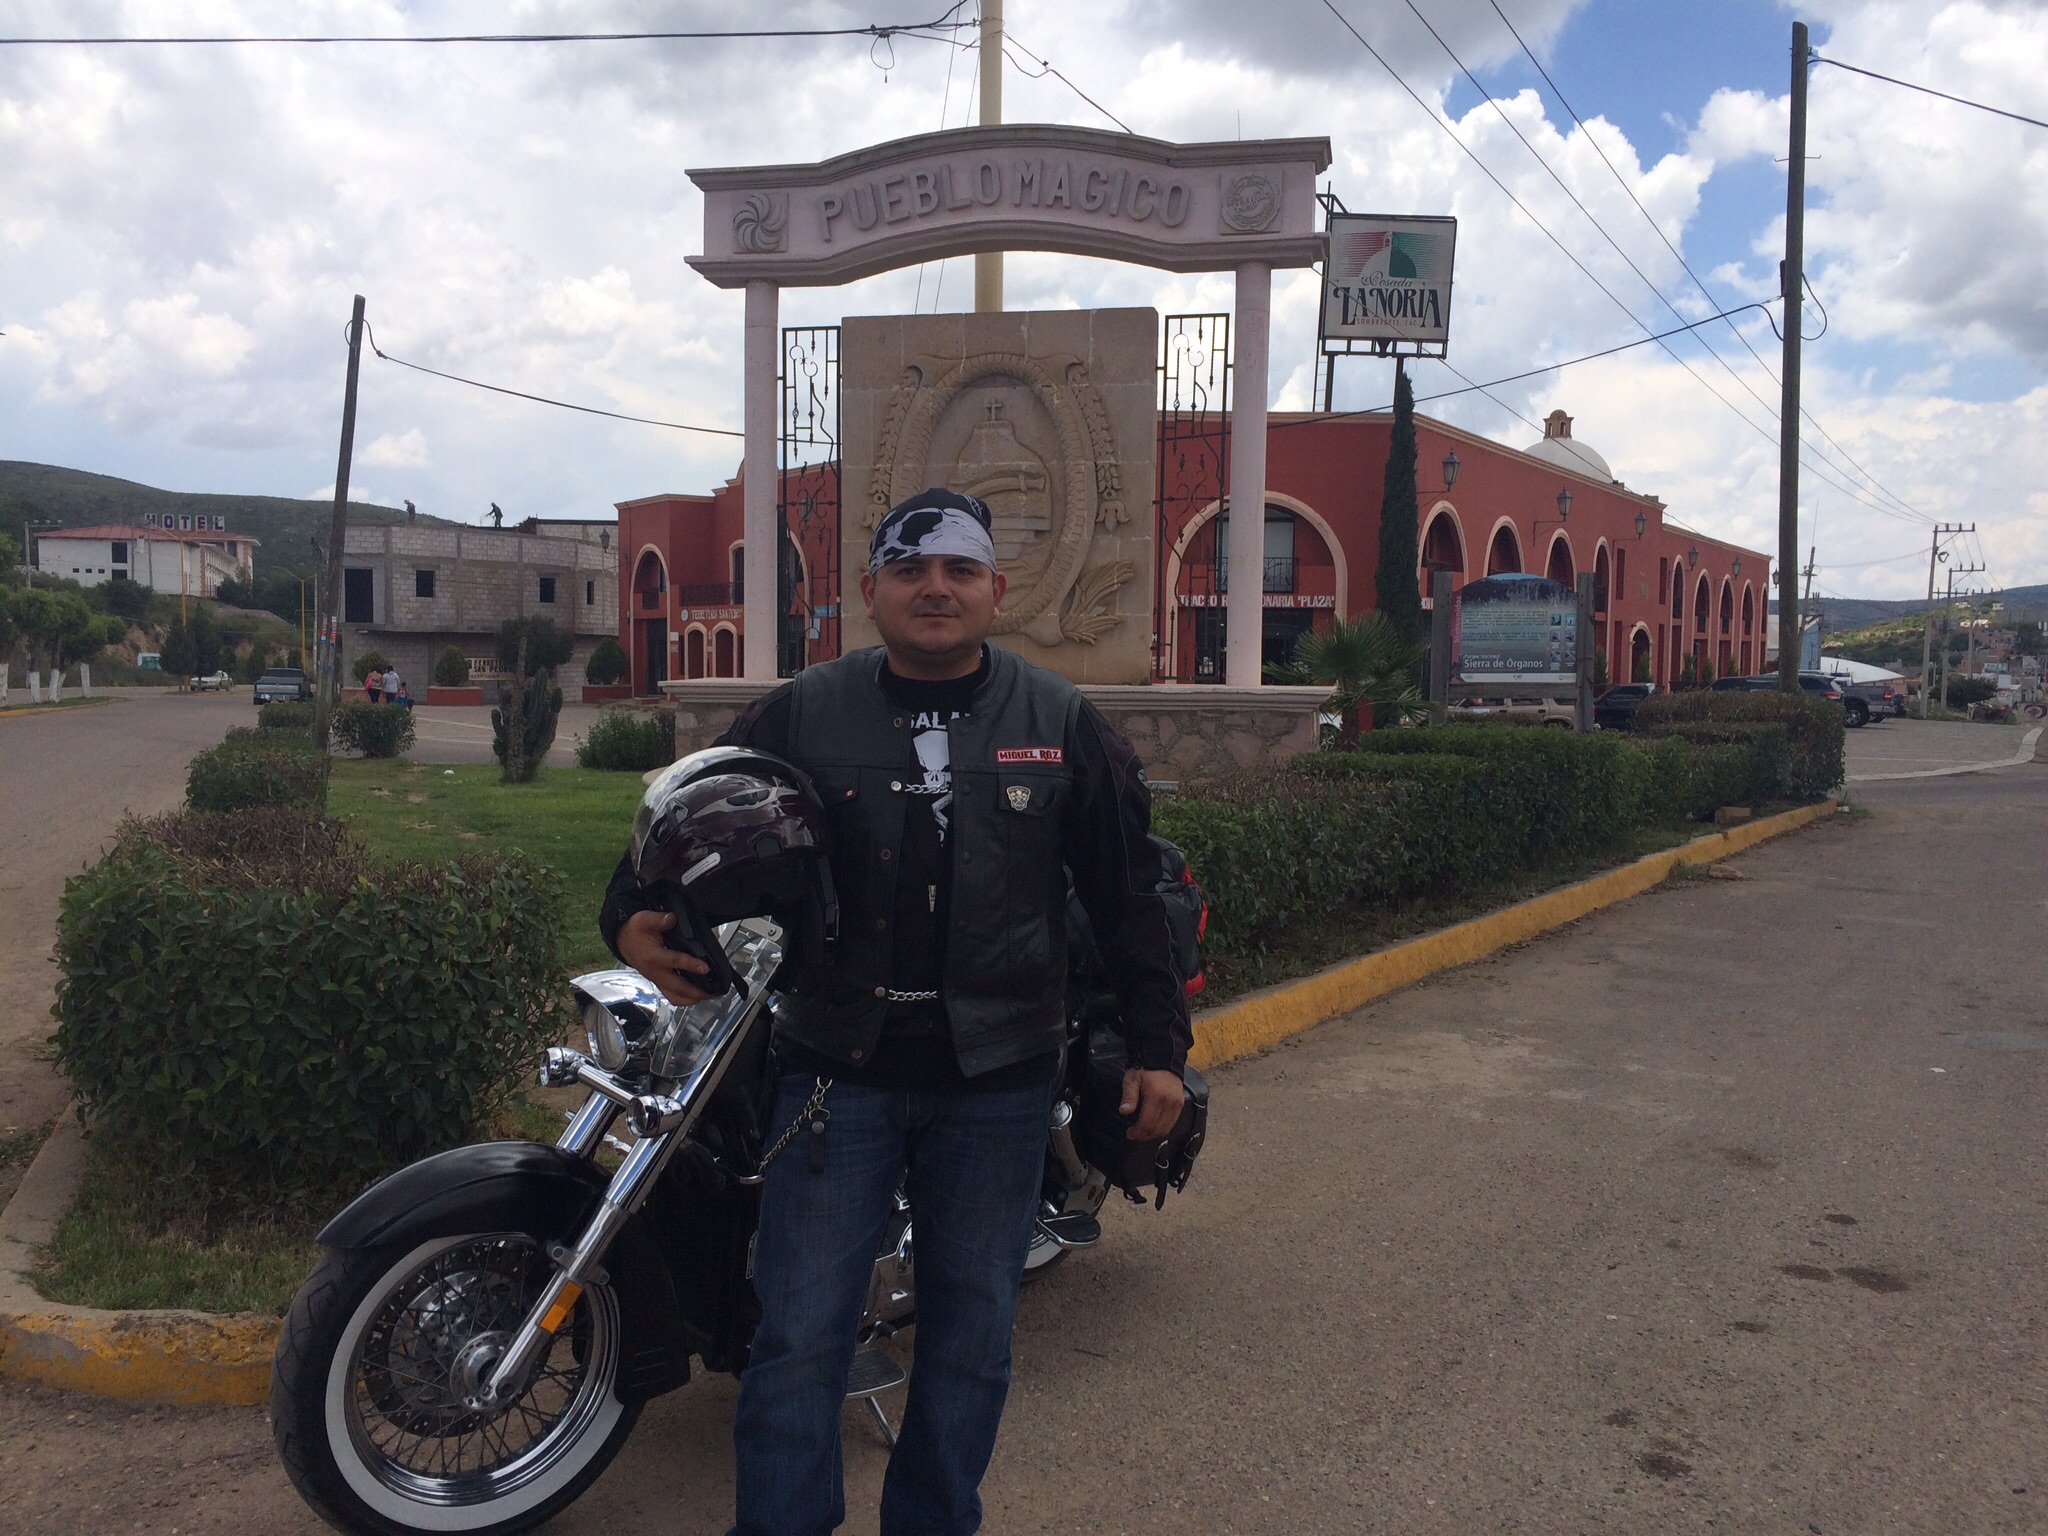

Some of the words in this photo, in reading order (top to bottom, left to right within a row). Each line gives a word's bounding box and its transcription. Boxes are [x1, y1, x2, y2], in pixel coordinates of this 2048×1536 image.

[819, 160, 1001, 242] PUEBLO
[1012, 158, 1190, 228] MAGICO
[1361, 271, 1413, 287] Posada
[145, 513, 224, 531] HOTEL
[1179, 595, 1217, 607] TRACO
[1464, 659, 1490, 668] Sierra
[1493, 659, 1504, 668] de
[1506, 657, 1543, 670] Órganos
[1000, 751, 1037, 759] MIGUEL
